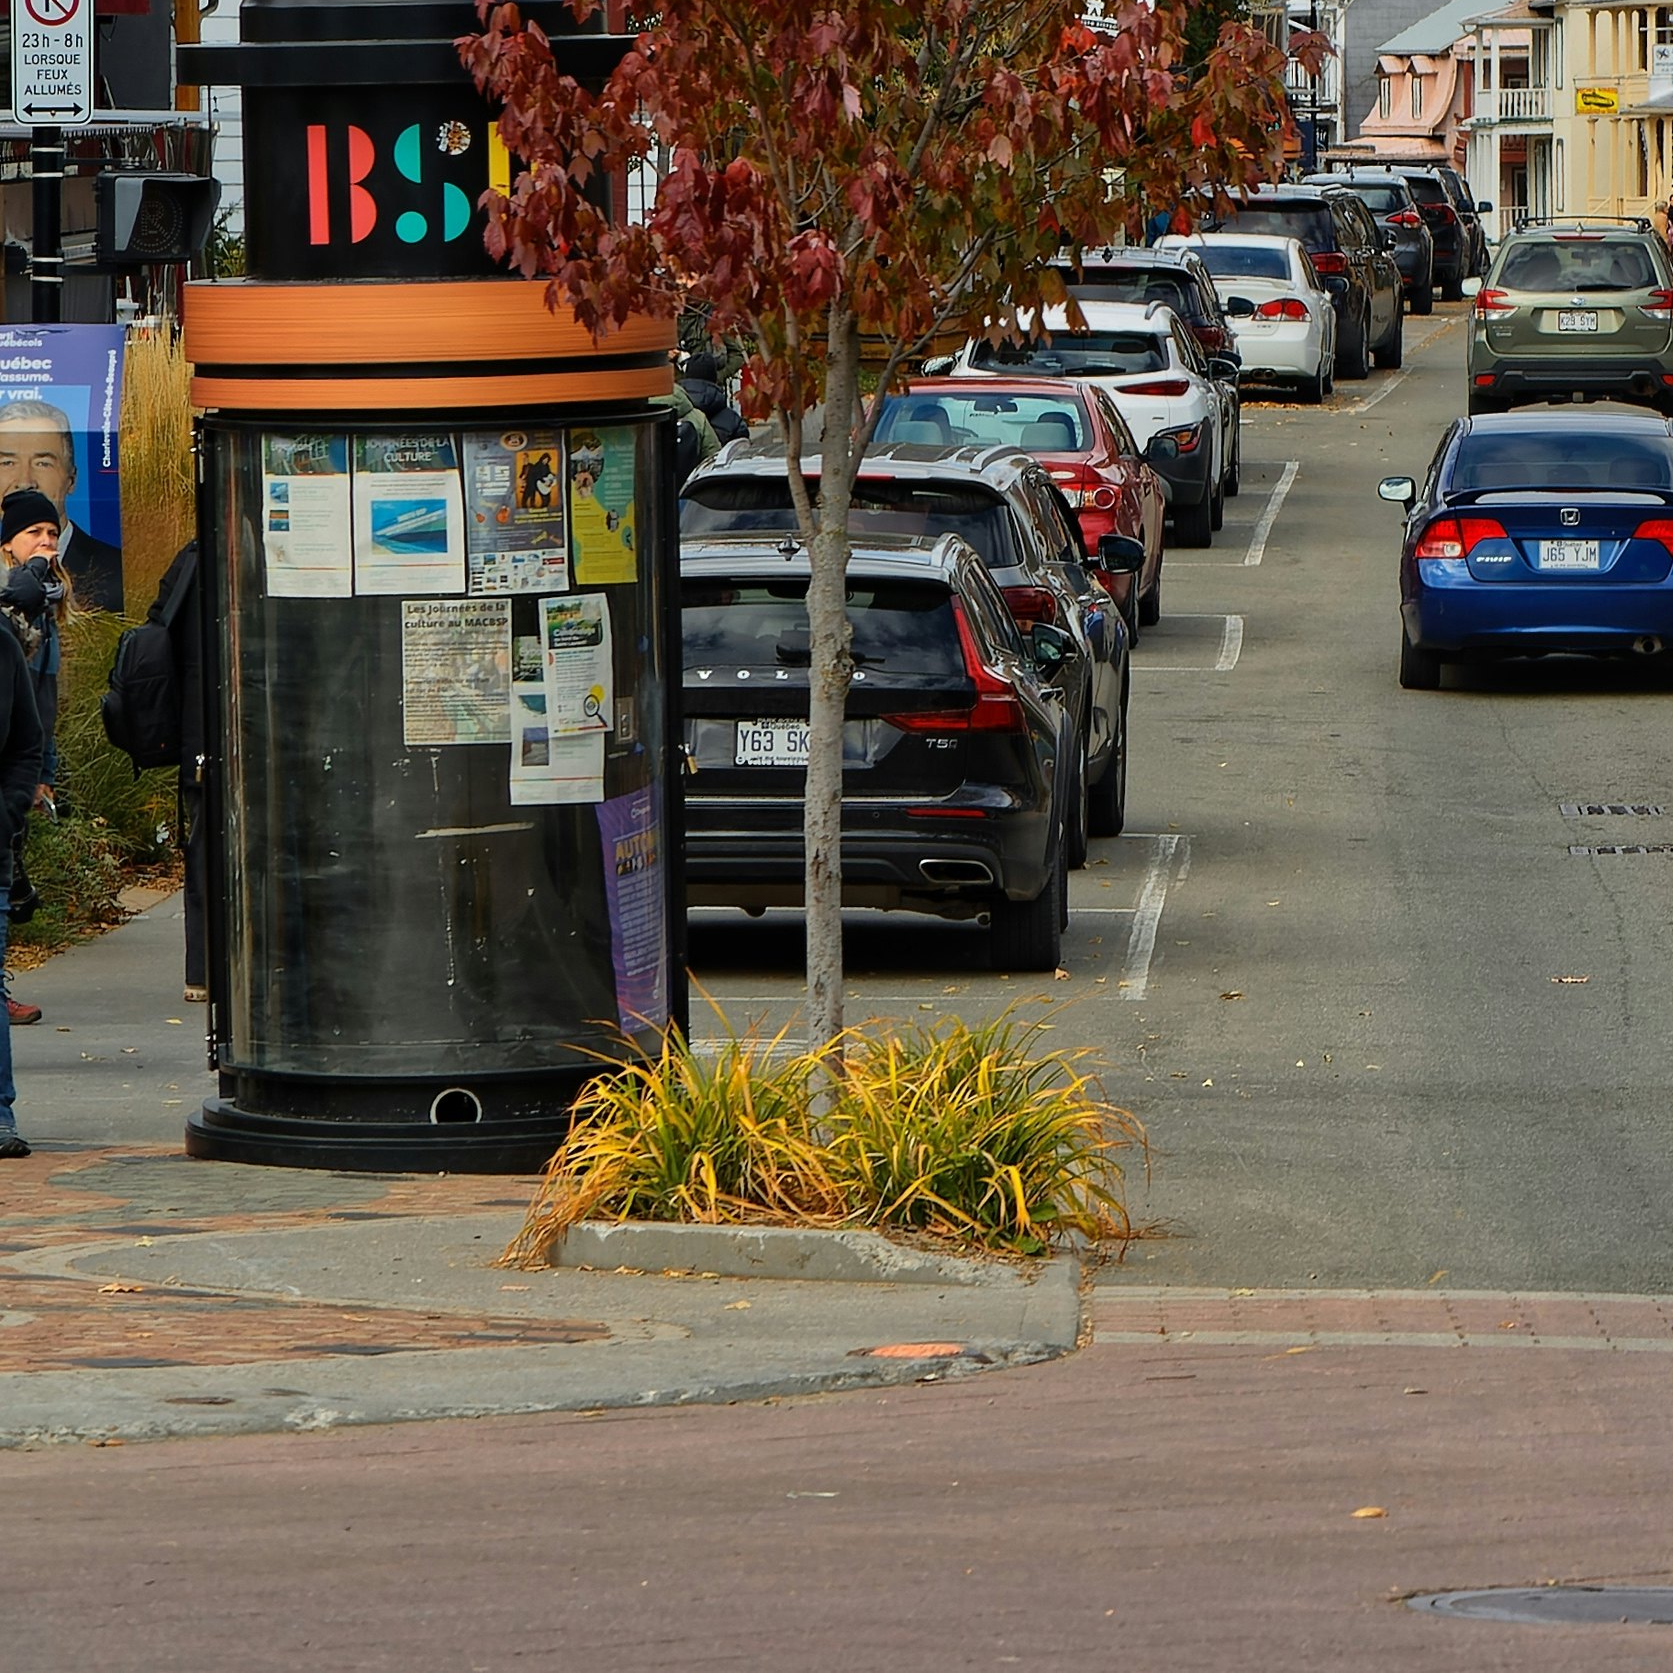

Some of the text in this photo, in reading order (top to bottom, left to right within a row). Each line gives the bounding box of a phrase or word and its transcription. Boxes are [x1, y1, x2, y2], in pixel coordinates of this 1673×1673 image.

[24, 54, 81, 65] LORSQUE
[37, 69, 68, 80] FEUX
[24, 83, 82, 95] ALLUMÉS
[0, 356, 53, 370] uébec
[8, 386, 43, 400] vrai.
[383, 450, 432, 463] CULTURE
[1542, 547, 1597, 562] J65 YJM
[407, 605, 426, 614] Les
[480, 602, 493, 612] de
[405, 619, 446, 629] culture
[448, 618, 462, 628] au
[697, 669, 866, 681] VOLO
[740, 730, 811, 752] Y63 SK
